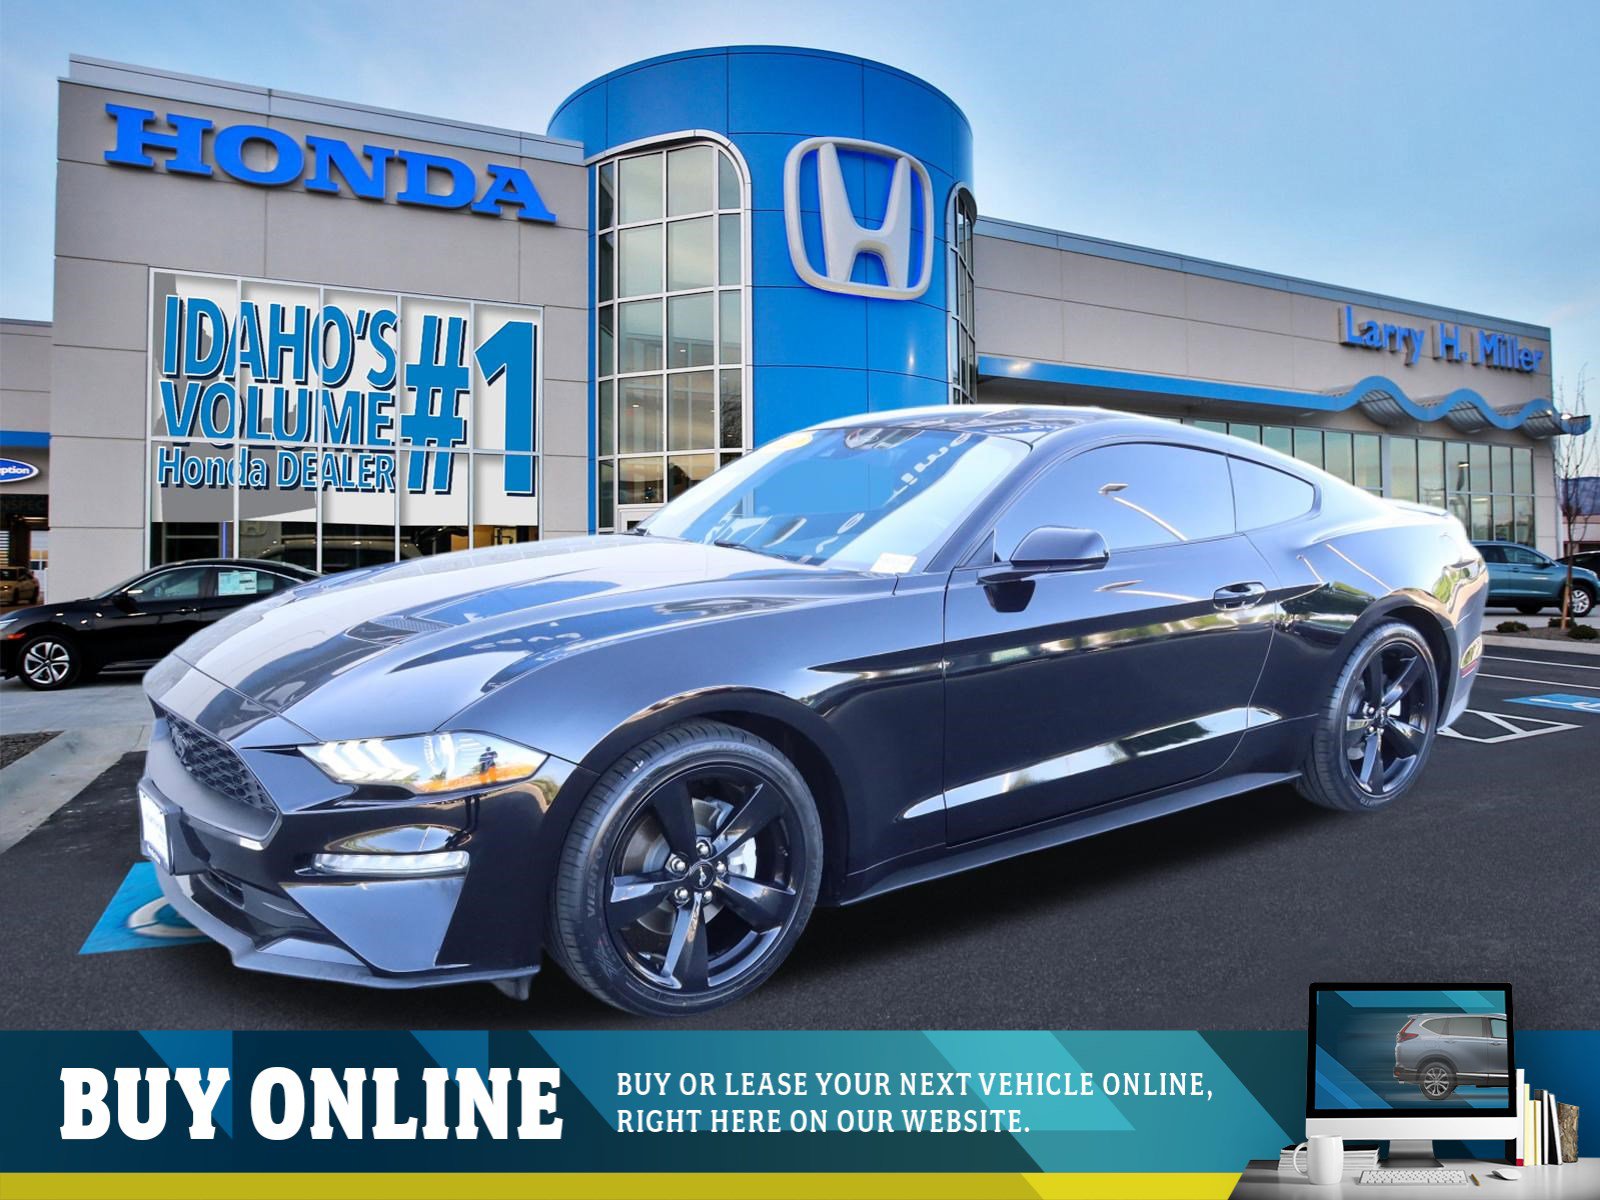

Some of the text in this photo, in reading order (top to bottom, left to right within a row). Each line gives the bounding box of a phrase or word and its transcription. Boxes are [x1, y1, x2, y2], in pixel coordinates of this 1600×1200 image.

[105, 102, 557, 224] HONDA
[162, 294, 399, 390] IDAHO'S
[1344, 304, 1545, 372] Larry H. Miller
[160, 379, 396, 447] VOLUME
[399, 314, 537, 496] #1
[157, 446, 396, 492] Honda DEALER
